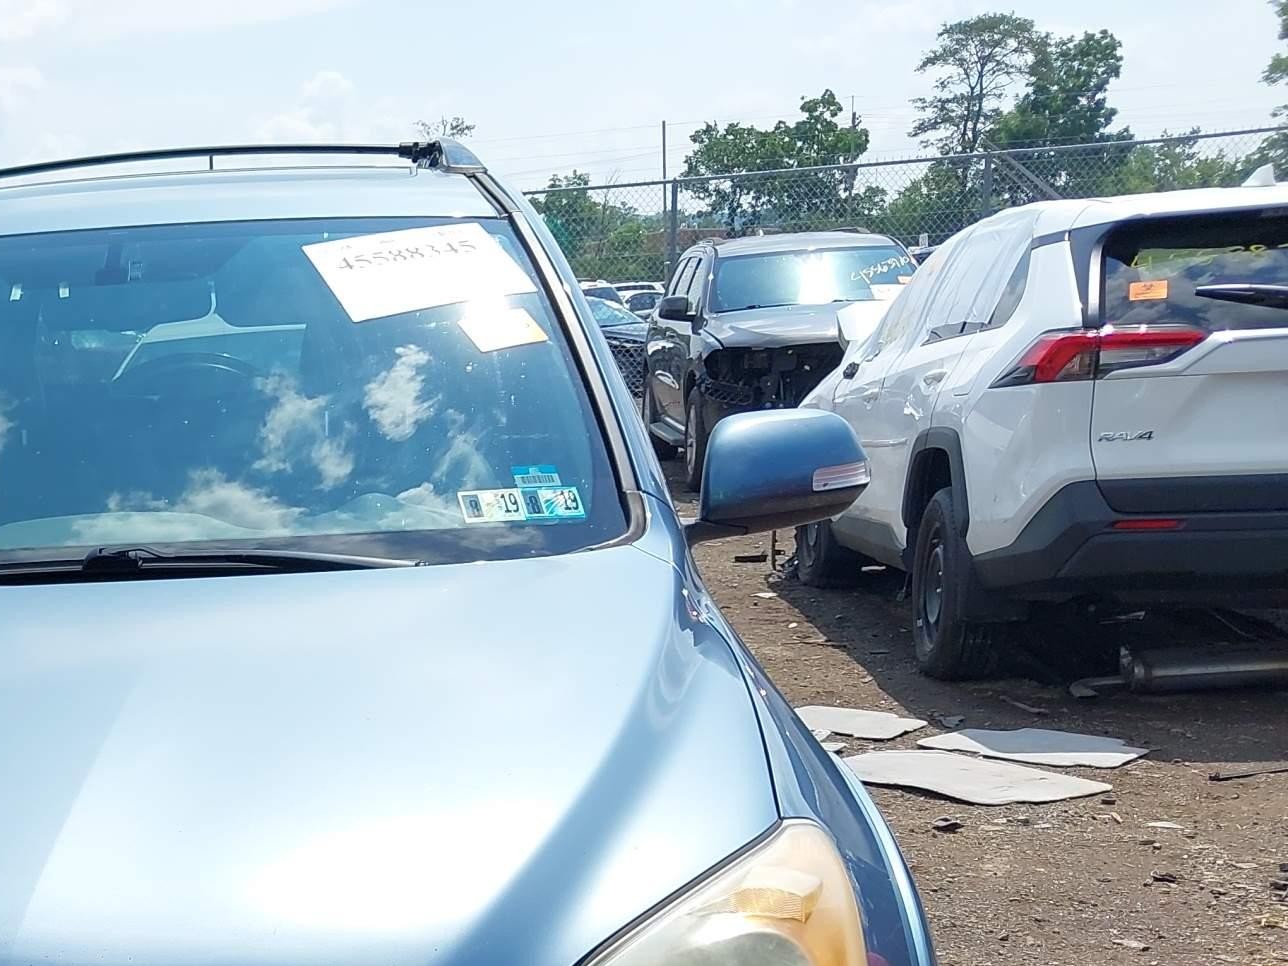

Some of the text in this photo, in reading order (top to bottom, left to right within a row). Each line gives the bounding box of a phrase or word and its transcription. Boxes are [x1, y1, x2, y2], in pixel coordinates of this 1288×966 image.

[1097, 430, 1155, 442] RAV4
[500, 492, 520, 514] 19
[559, 490, 580, 511] 19
